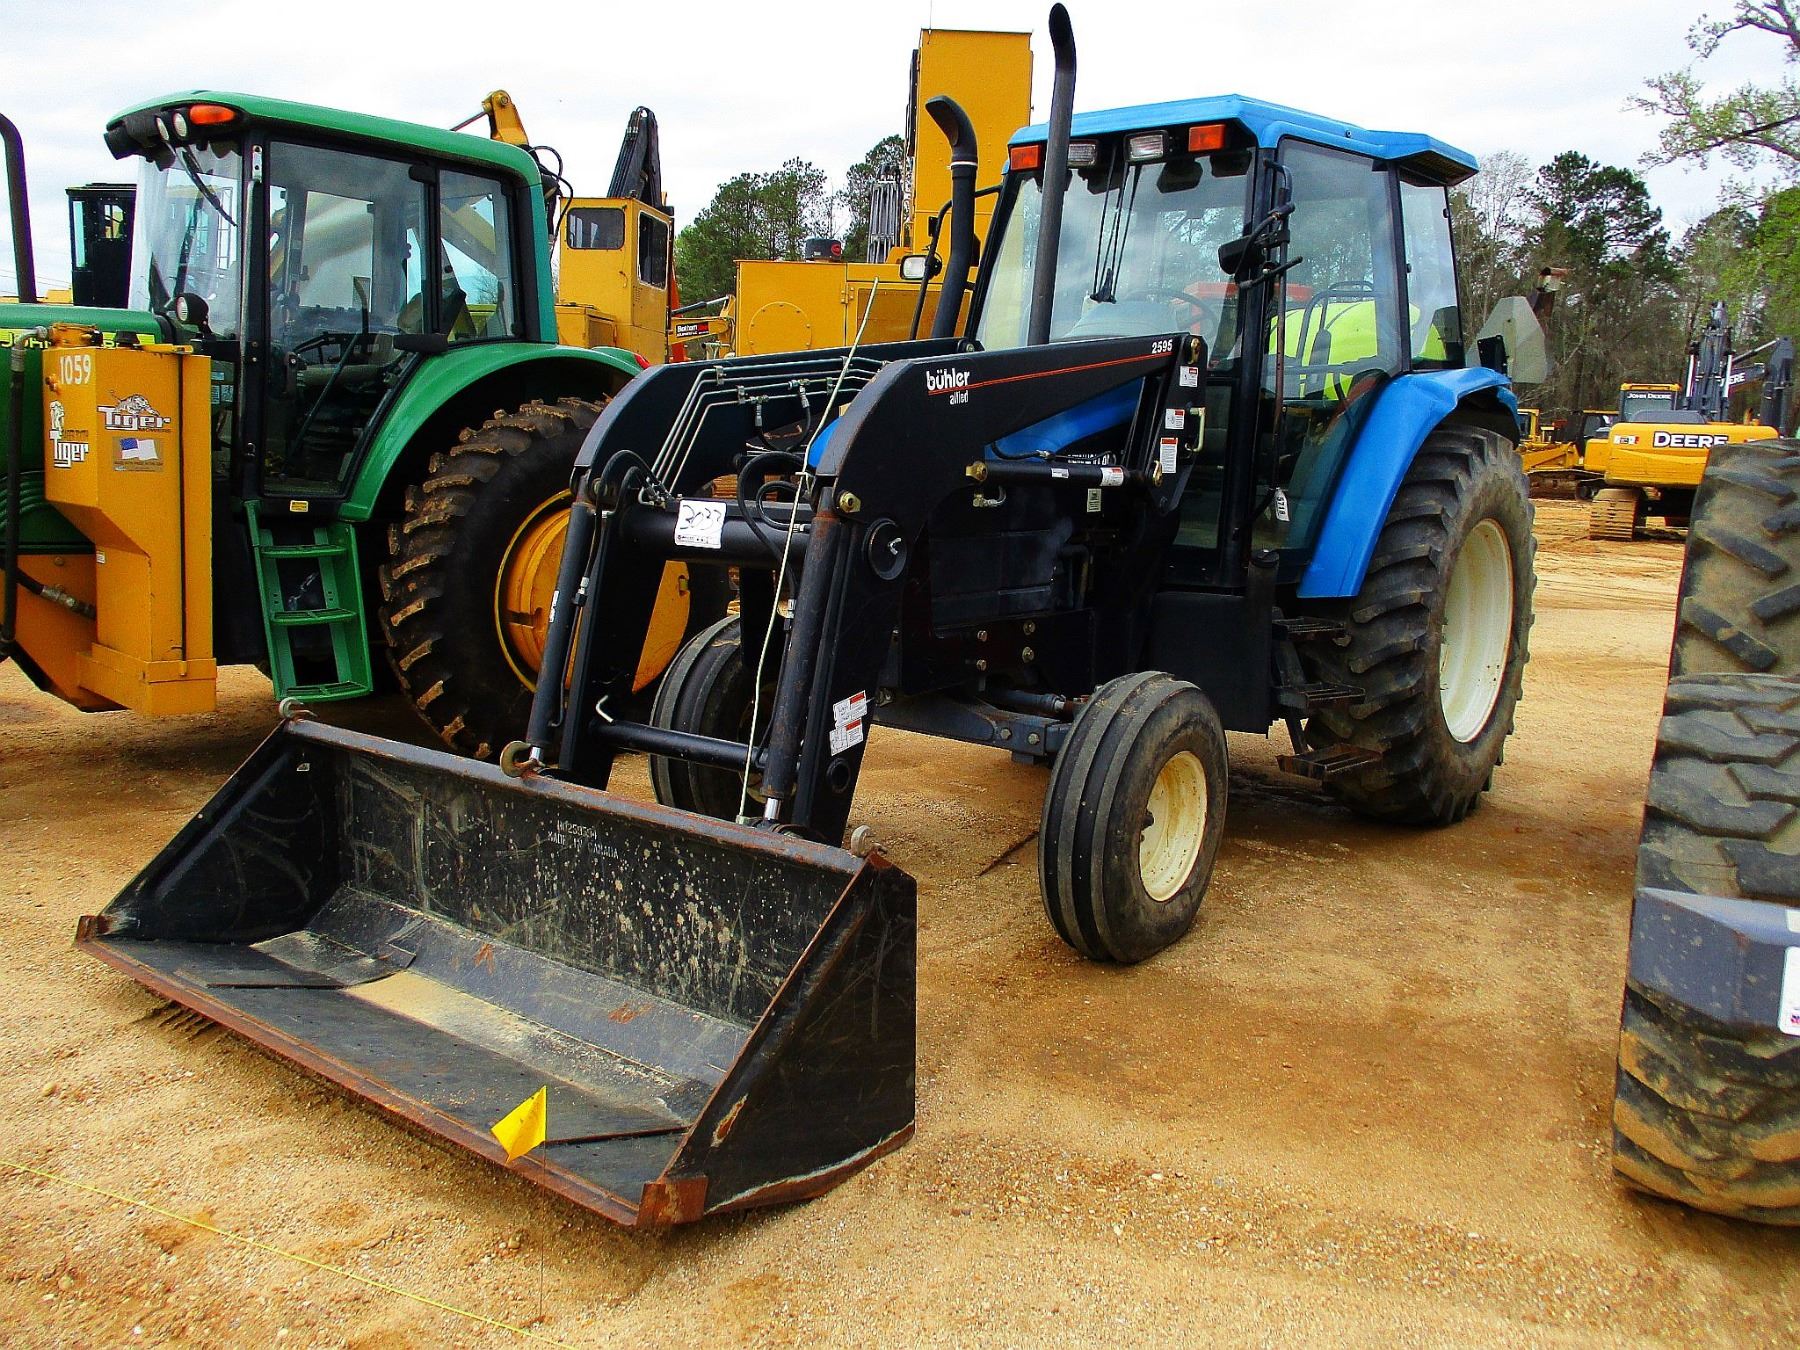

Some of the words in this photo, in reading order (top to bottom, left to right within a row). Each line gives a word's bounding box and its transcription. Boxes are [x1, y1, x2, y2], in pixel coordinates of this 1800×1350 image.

[1151, 339, 1173, 354] 2595
[60, 354, 91, 385] 1059
[926, 367, 970, 391] bühler
[97, 405, 171, 431] Tiger
[49, 430, 89, 468] Tiger
[1653, 431, 1728, 448] DEERE
